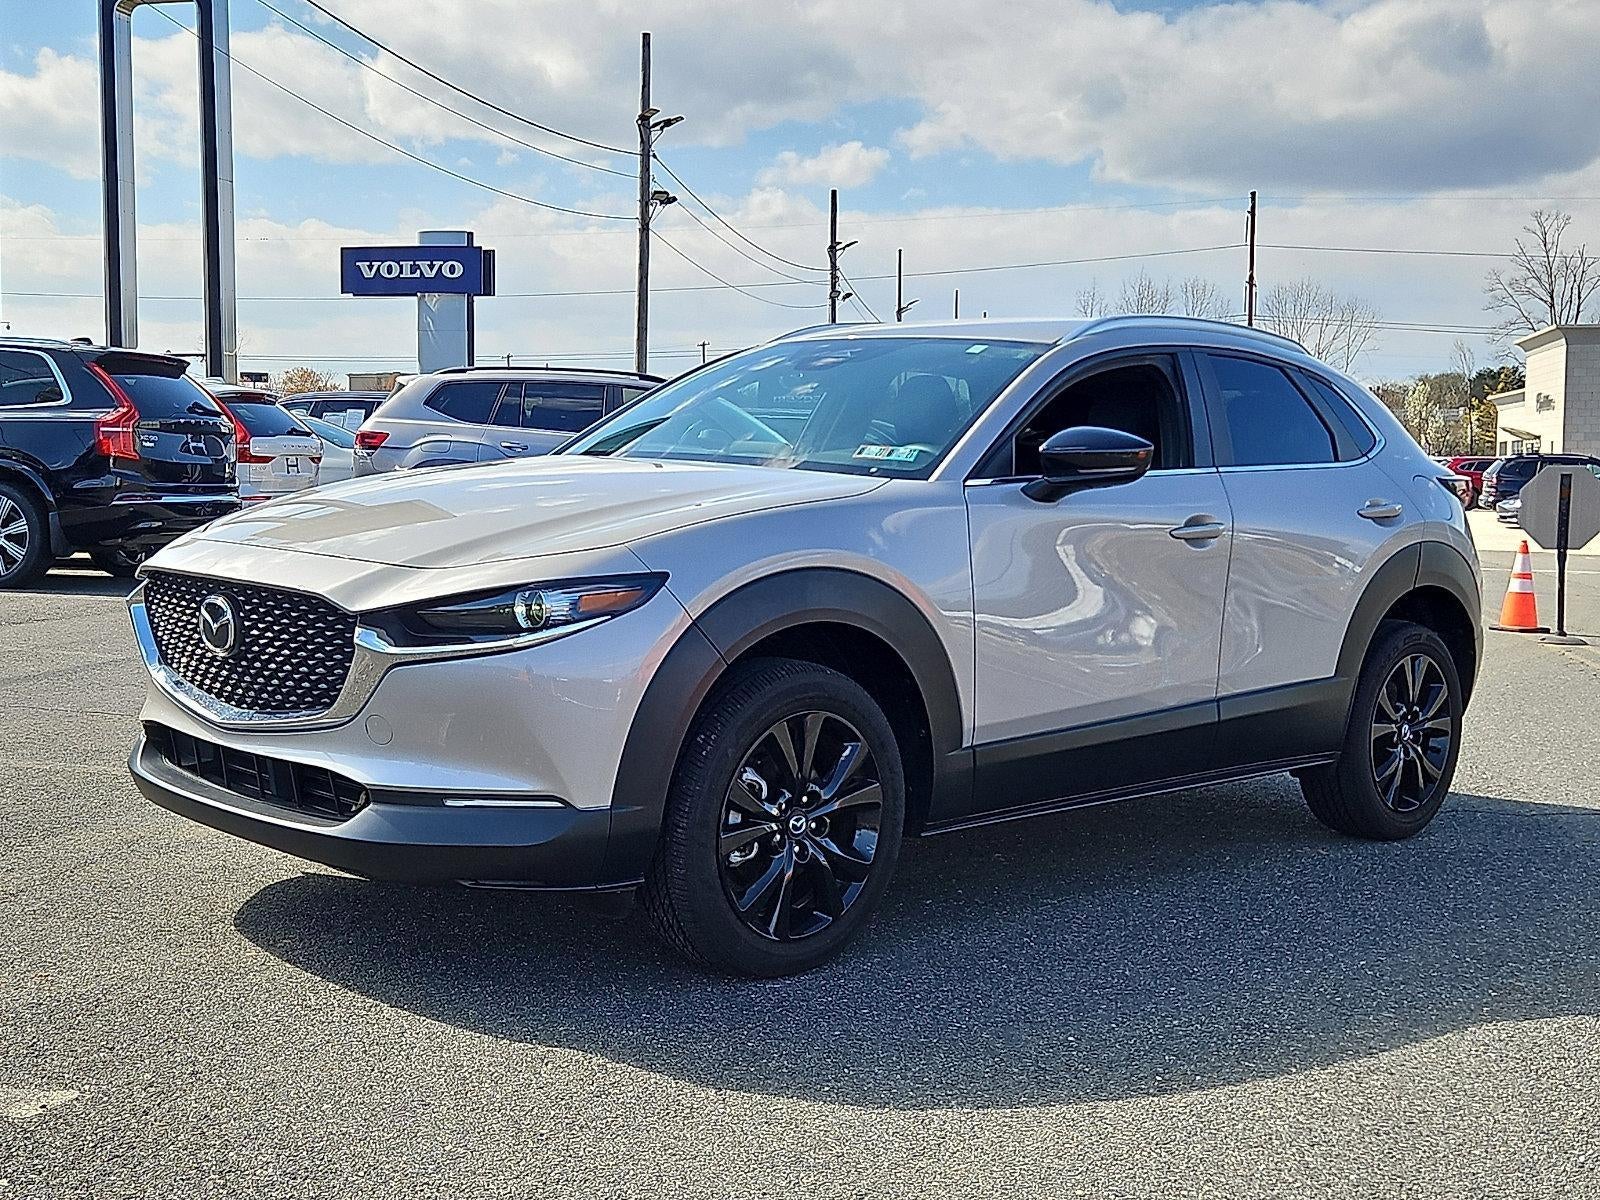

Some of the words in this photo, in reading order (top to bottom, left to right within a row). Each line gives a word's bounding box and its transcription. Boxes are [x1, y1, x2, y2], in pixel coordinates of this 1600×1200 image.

[356, 261, 464, 279] VOLVO
[187, 433, 207, 456] H
[286, 457, 301, 475] H
